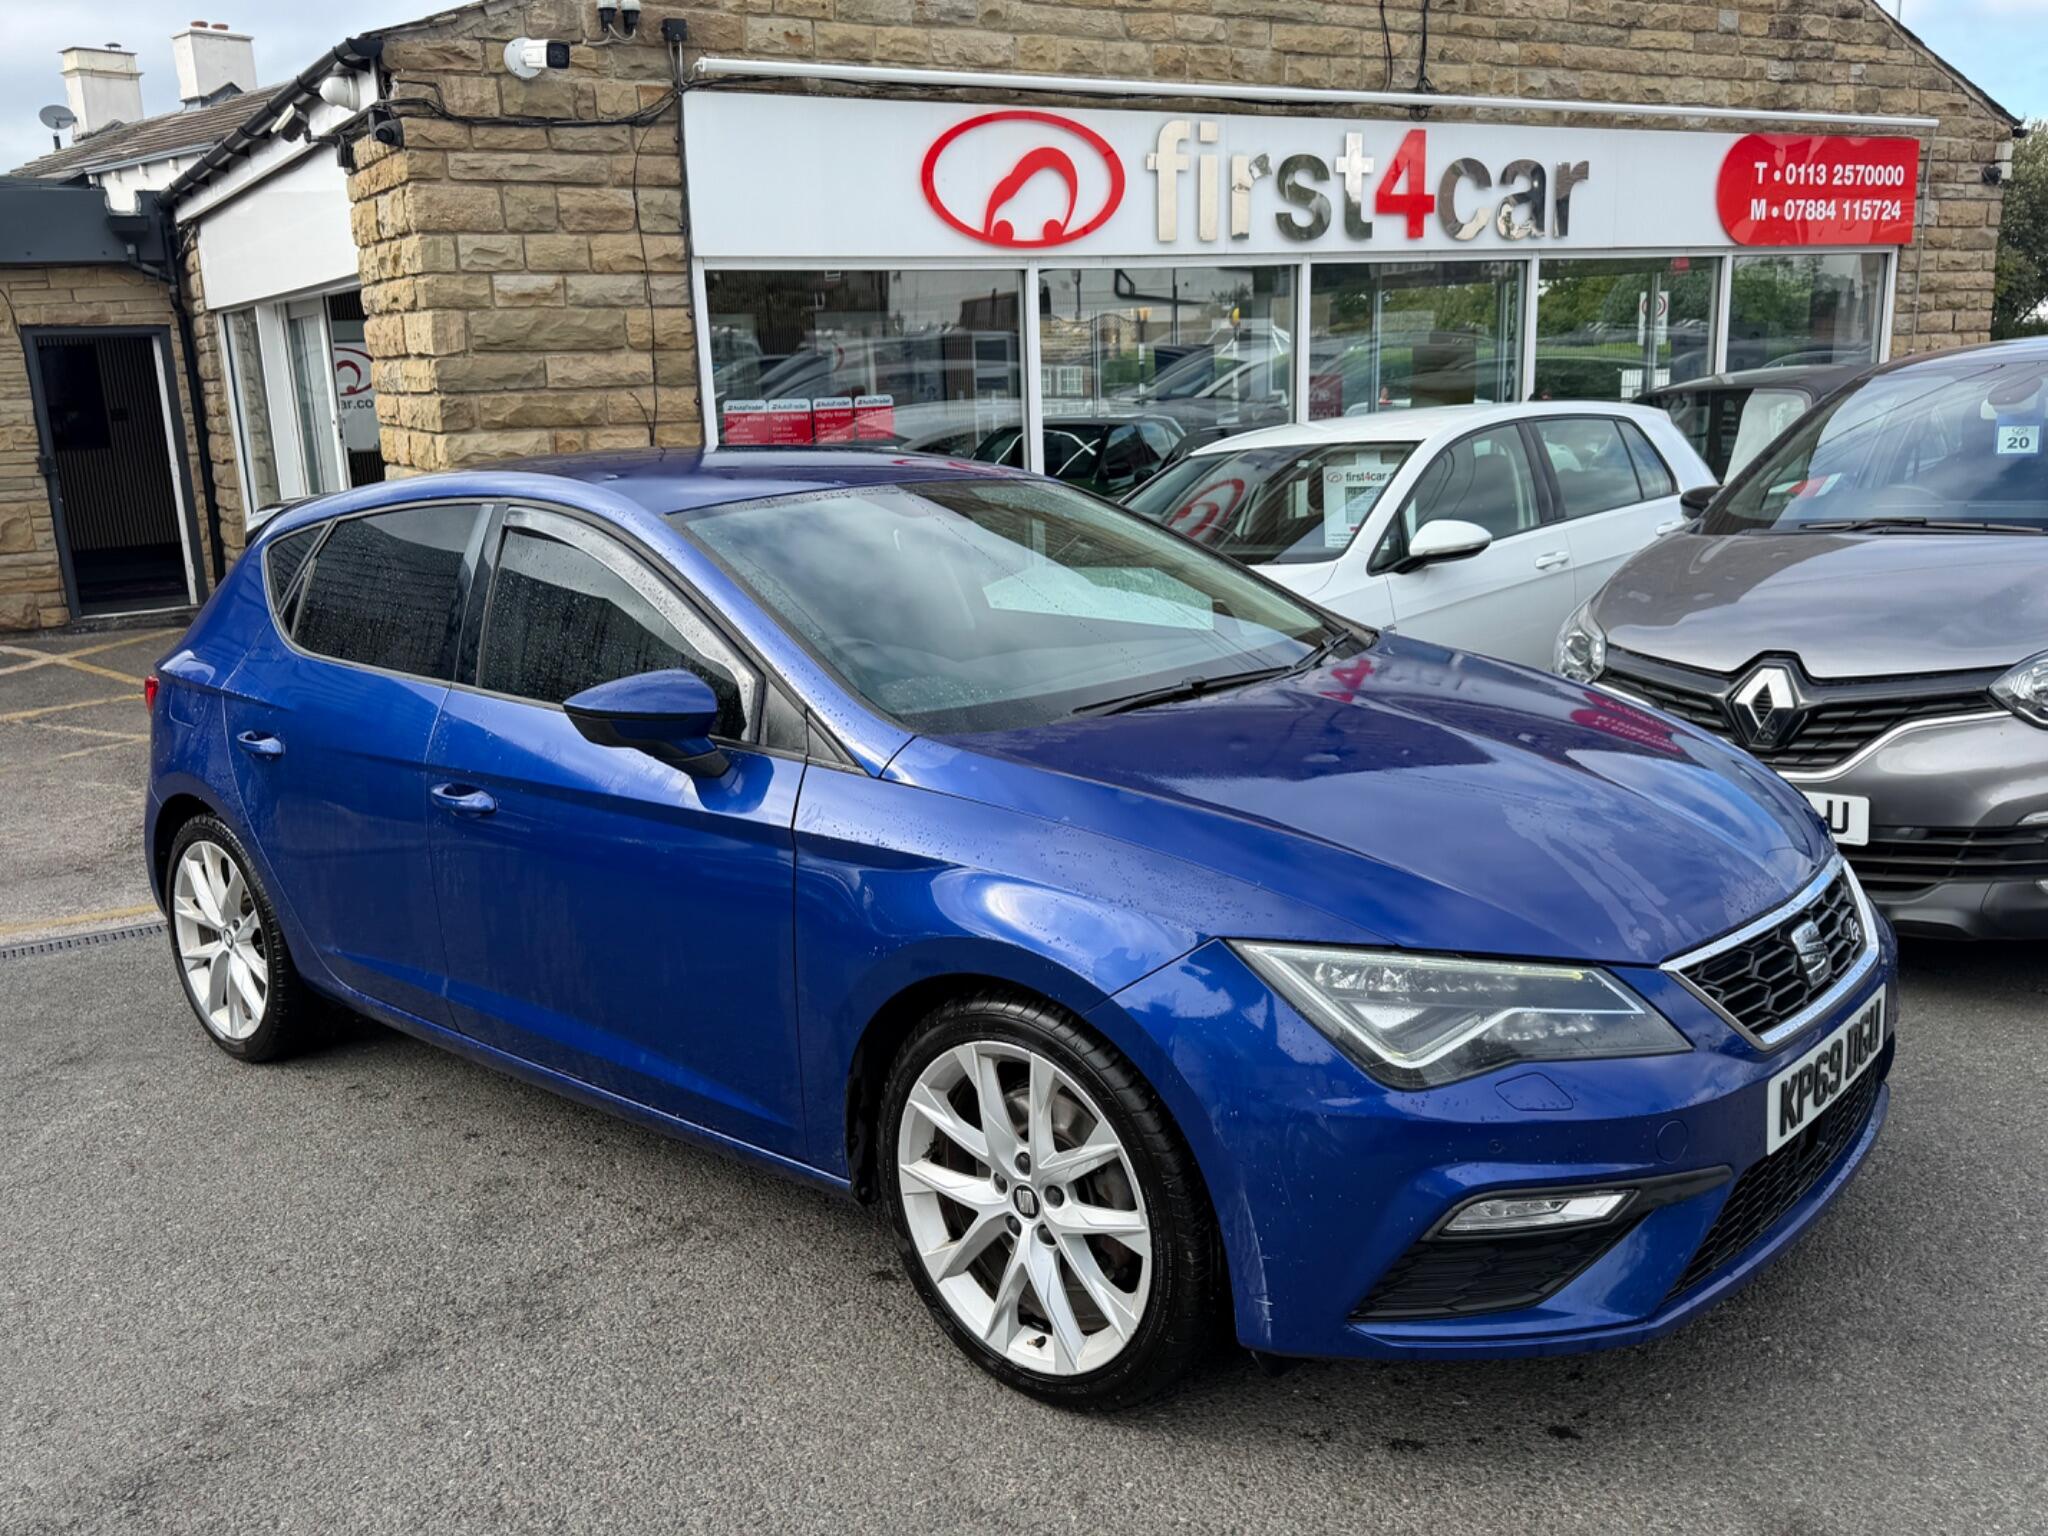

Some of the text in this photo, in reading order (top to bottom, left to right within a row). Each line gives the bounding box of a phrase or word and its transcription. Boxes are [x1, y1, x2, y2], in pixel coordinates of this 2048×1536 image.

[1146, 120, 1590, 242] first4car
[1754, 161, 1905, 186] T 0113 2570000
[1750, 198, 1902, 221] M 07884 115724
[2007, 436, 2031, 450] 20
[1780, 1038, 1844, 1138] KP69
